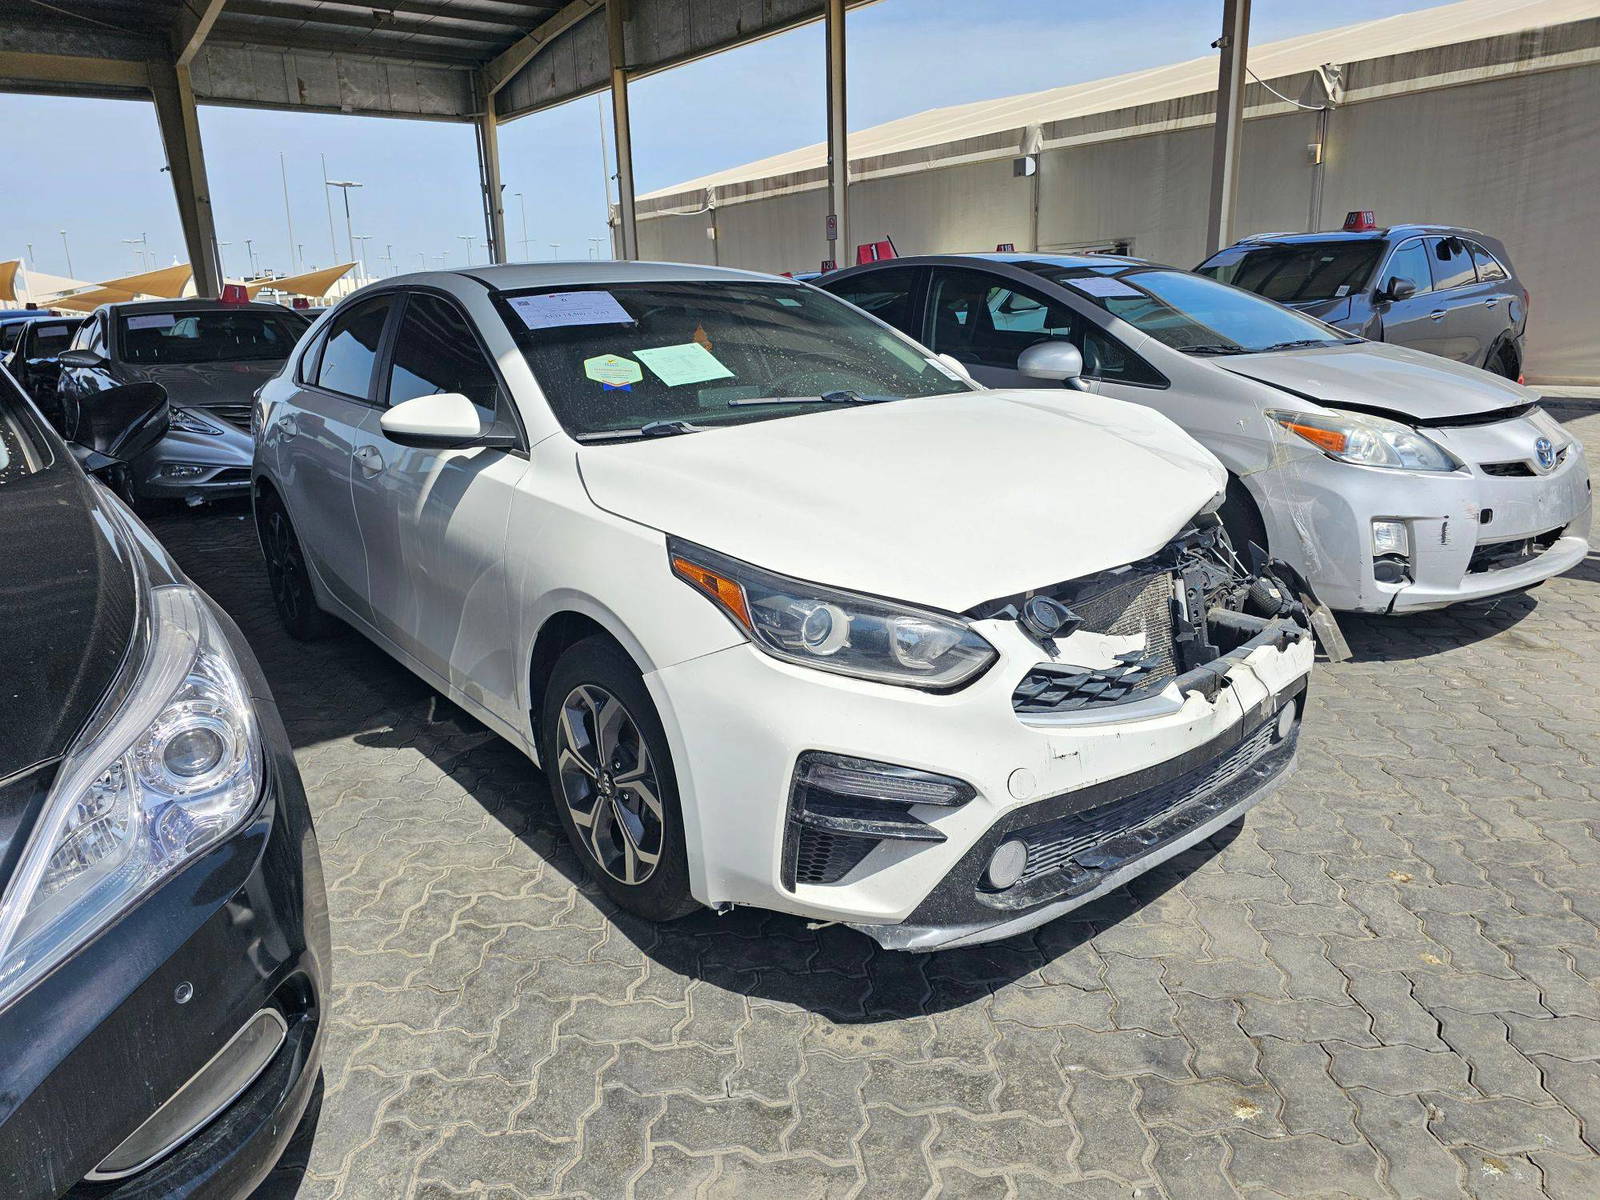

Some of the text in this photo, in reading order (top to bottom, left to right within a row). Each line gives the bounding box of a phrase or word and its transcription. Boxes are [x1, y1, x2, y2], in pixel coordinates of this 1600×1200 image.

[871, 244, 878, 261] 1
[823, 261, 834, 270] 120
[603, 773, 611, 794] KIA
